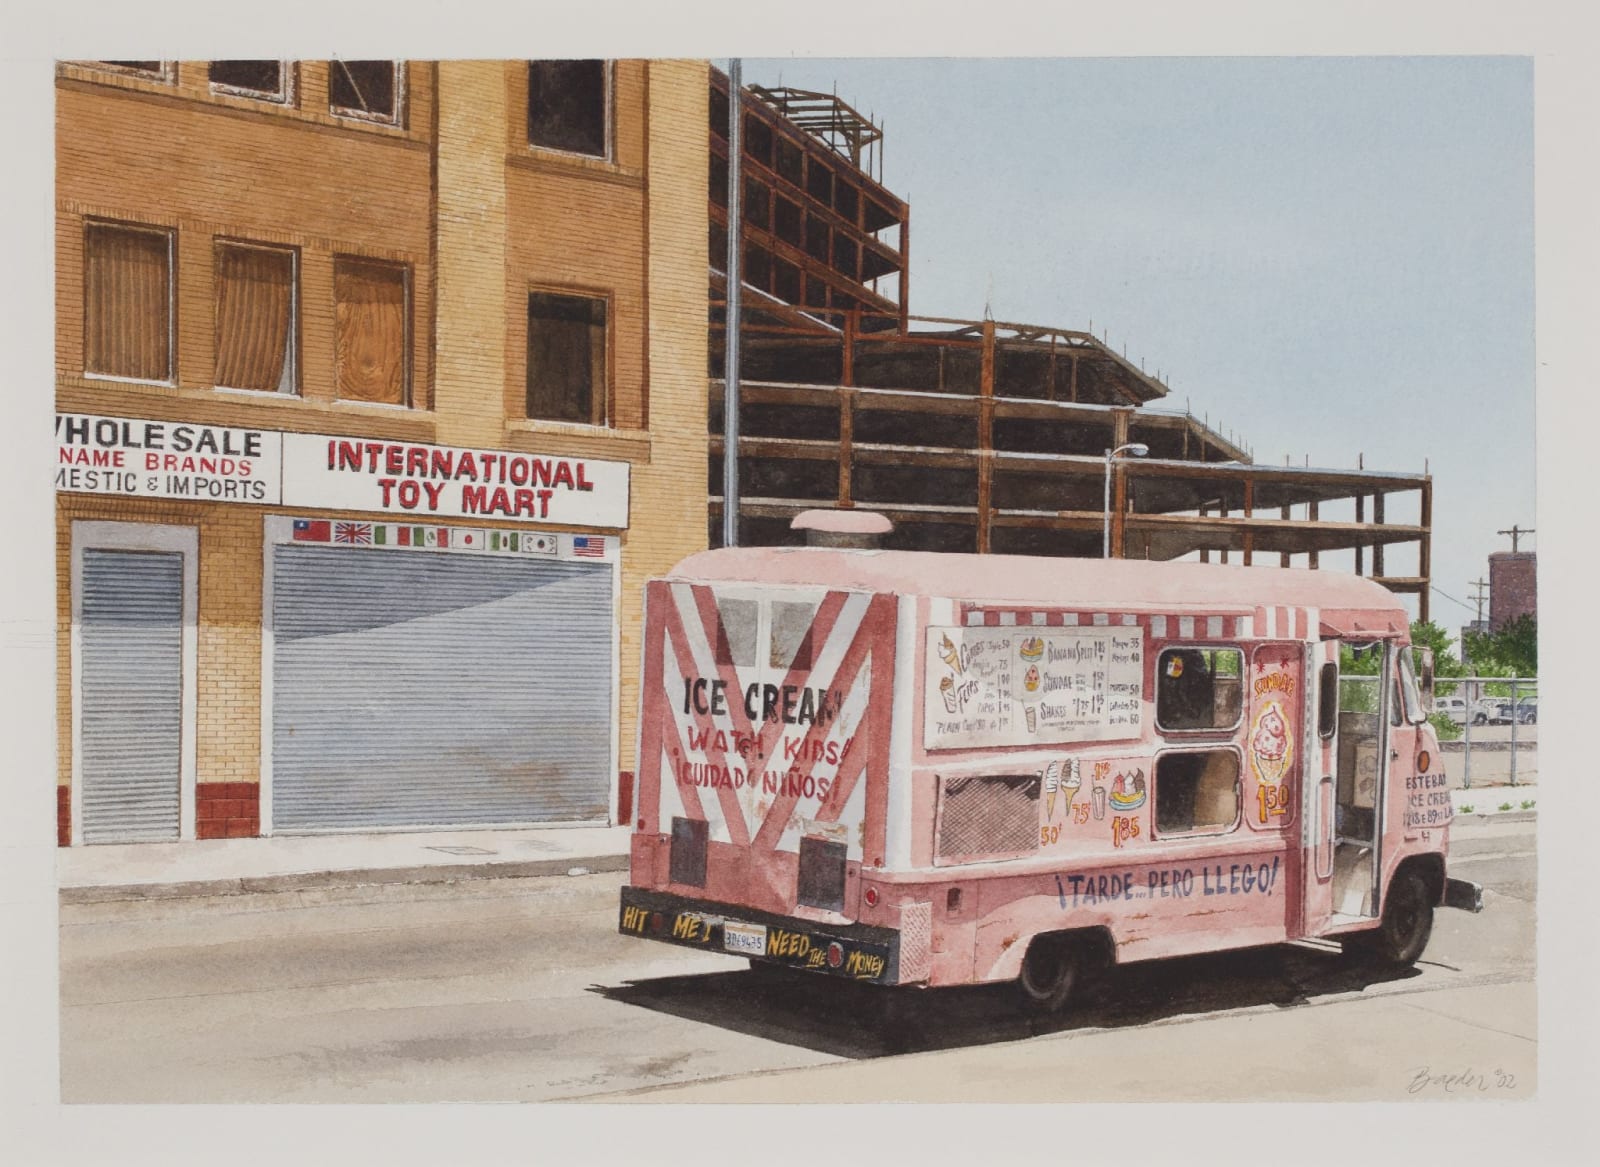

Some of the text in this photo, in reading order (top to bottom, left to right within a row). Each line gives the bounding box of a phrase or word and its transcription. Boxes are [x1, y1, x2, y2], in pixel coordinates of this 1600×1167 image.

[55, 415, 262, 458] HOLESALE
[59, 446, 252, 476] NAME BRANDS
[327, 440, 594, 491] INTERNATIONAL
[147, 476, 159, 491] &
[166, 475, 266, 499] IMPORTS
[378, 478, 553, 518] TOY MART
[683, 677, 728, 716] ICE
[1254, 672, 1295, 701] SUNDAE
[1408, 793, 1424, 807] ICE
[1148, 869, 1194, 899] PERO
[1203, 856, 1280, 897] LLEGO!
[622, 905, 648, 933] HIT
[674, 914, 702, 939] ME
[768, 929, 885, 979] NEED THE MONEY
